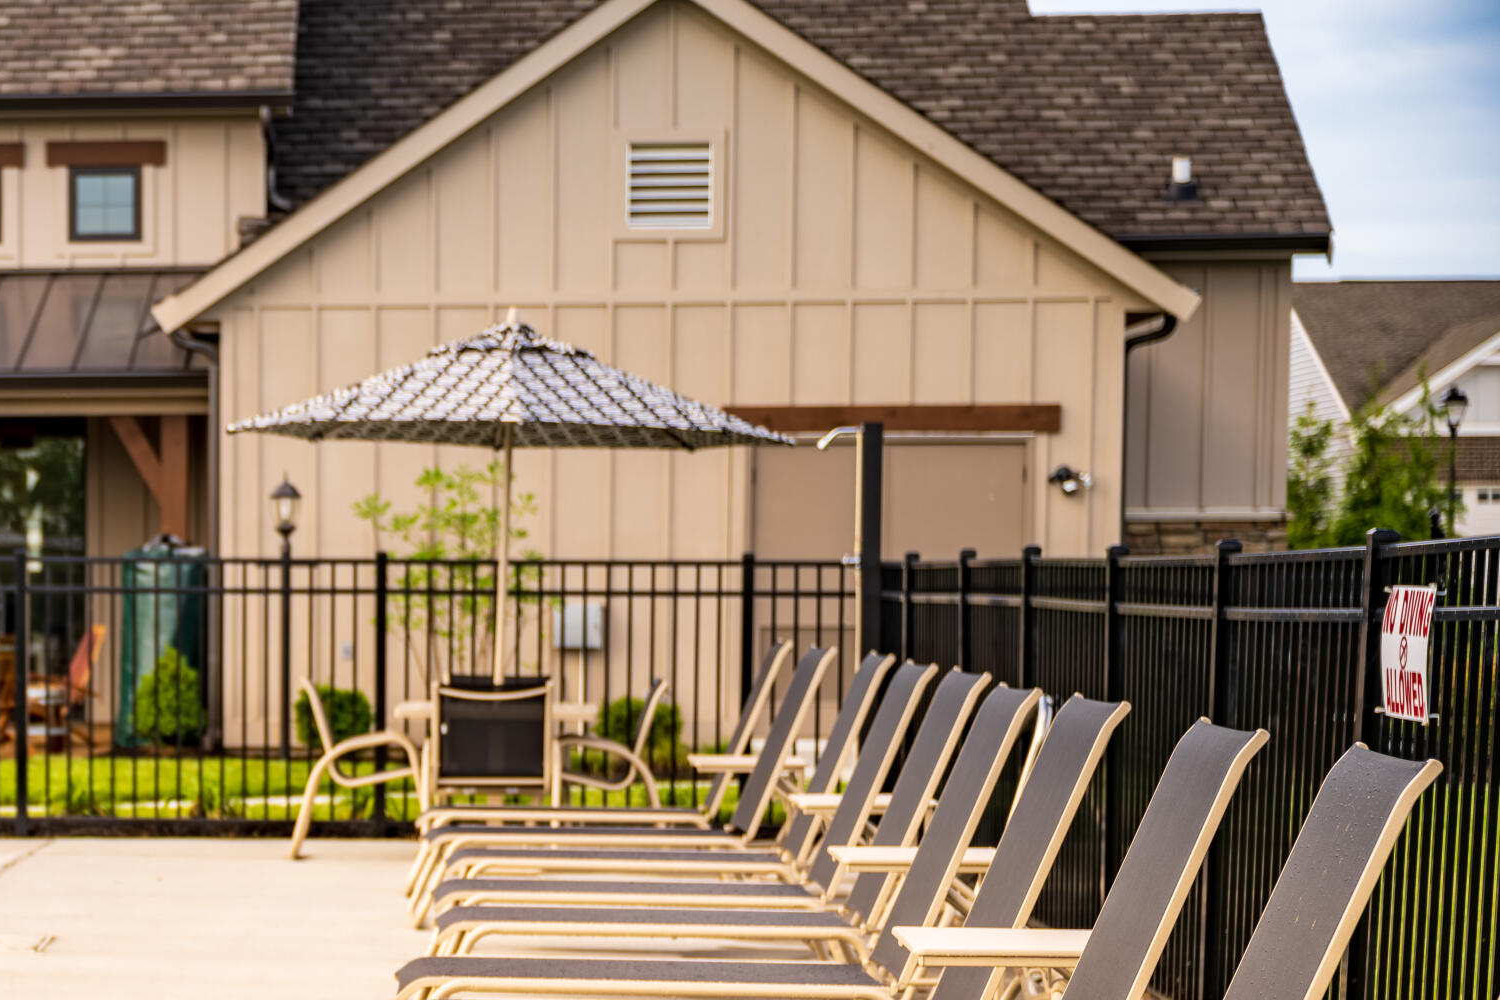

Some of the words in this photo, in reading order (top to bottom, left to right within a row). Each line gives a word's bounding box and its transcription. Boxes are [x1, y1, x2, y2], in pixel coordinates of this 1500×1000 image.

[1383, 589, 1399, 635] NO
[1399, 590, 1434, 638] DIVING
[1386, 667, 1426, 718] ALLOWED
